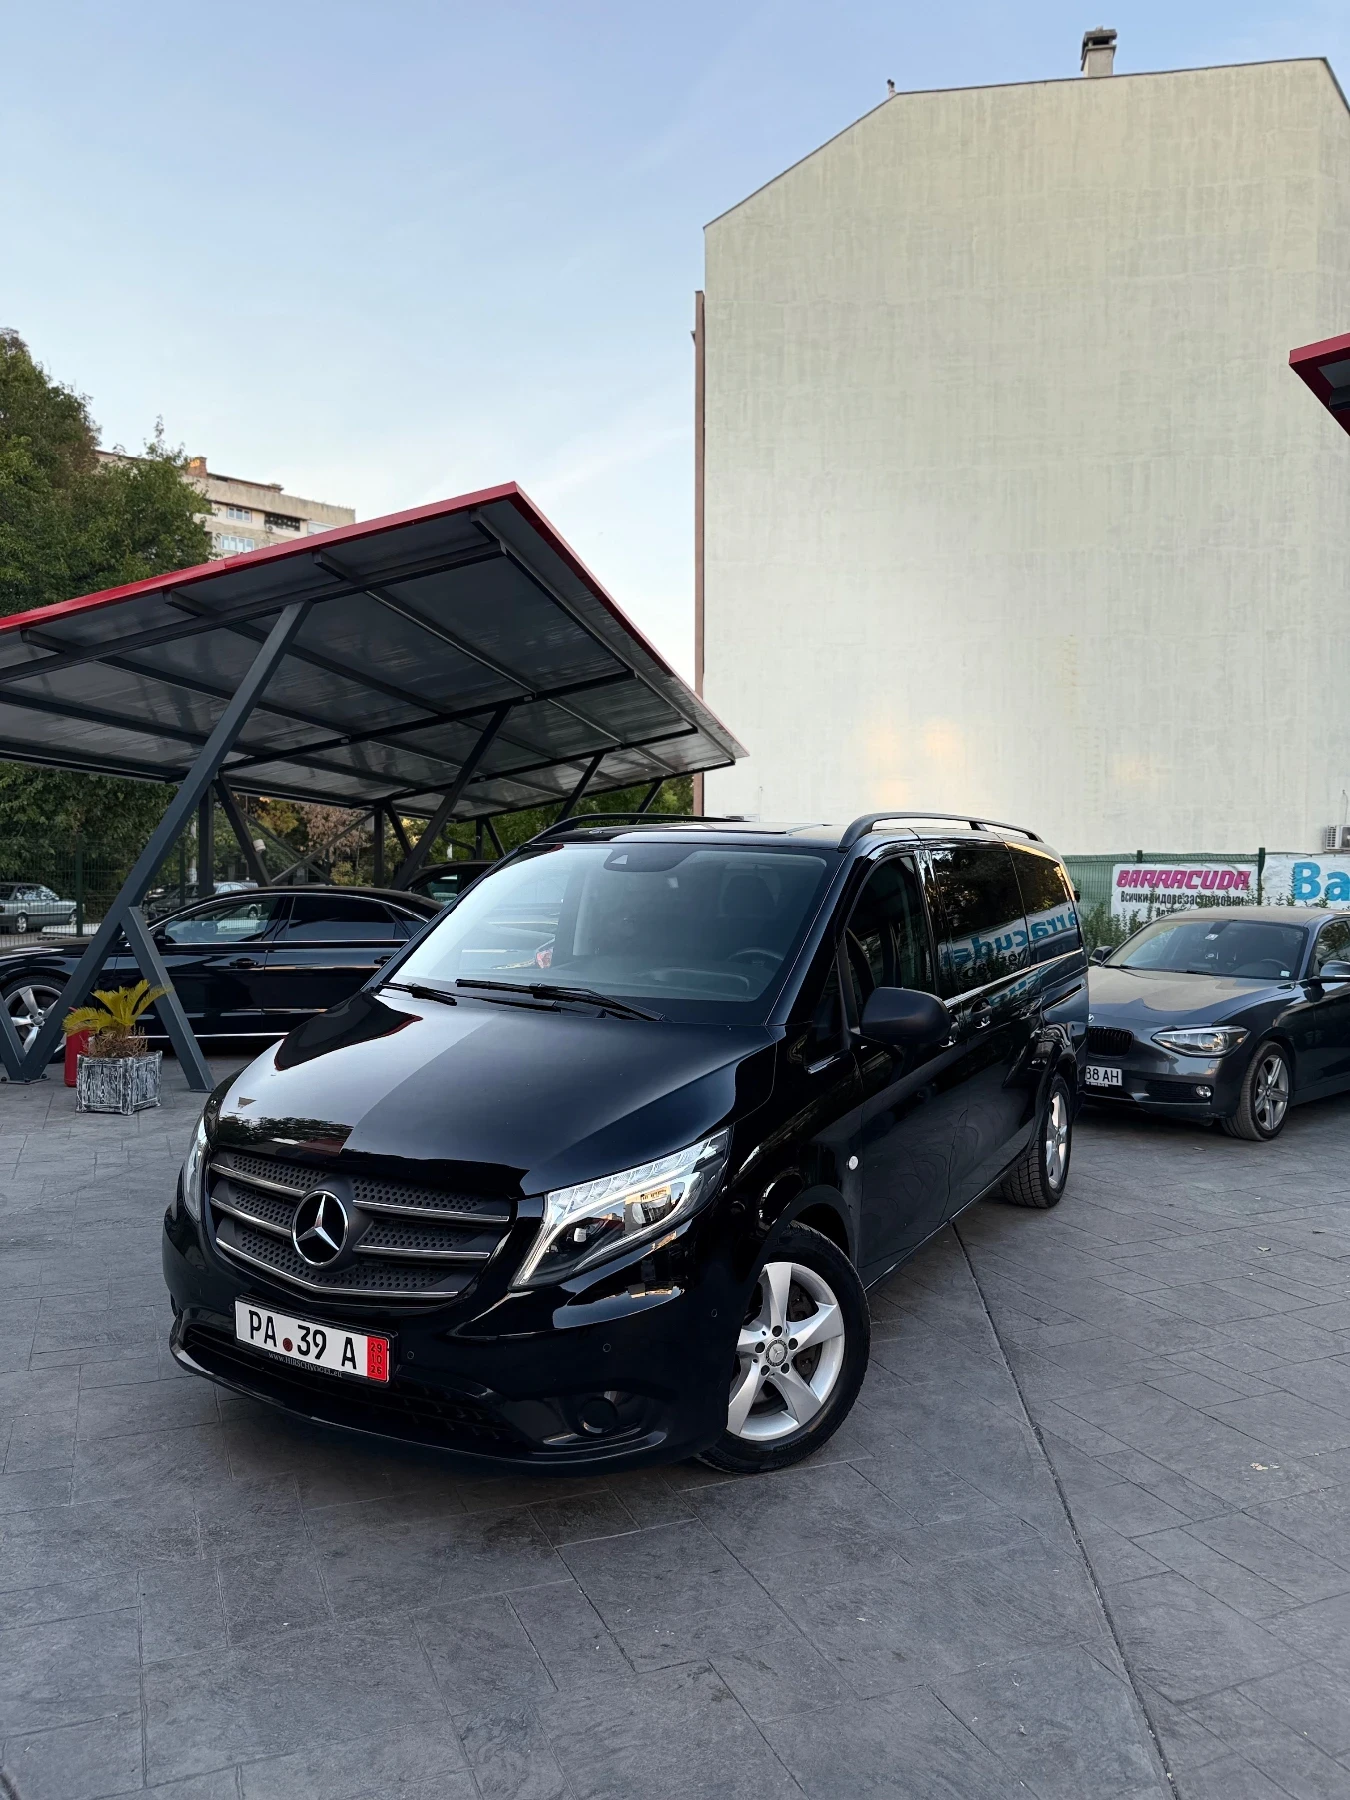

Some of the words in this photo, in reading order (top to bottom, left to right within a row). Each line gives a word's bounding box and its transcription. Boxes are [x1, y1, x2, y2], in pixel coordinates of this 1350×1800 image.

[1116, 870, 1251, 890] BARRACUDA
[1121, 891, 1148, 903] Всички
[1102, 1070, 1119, 1083] AH
[249, 1310, 277, 1347] PA
[297, 1324, 327, 1360] 39
[341, 1337, 357, 1369] A
[370, 1342, 382, 1354] 29
[372, 1354, 382, 1364] 10
[370, 1364, 382, 1374] 26
